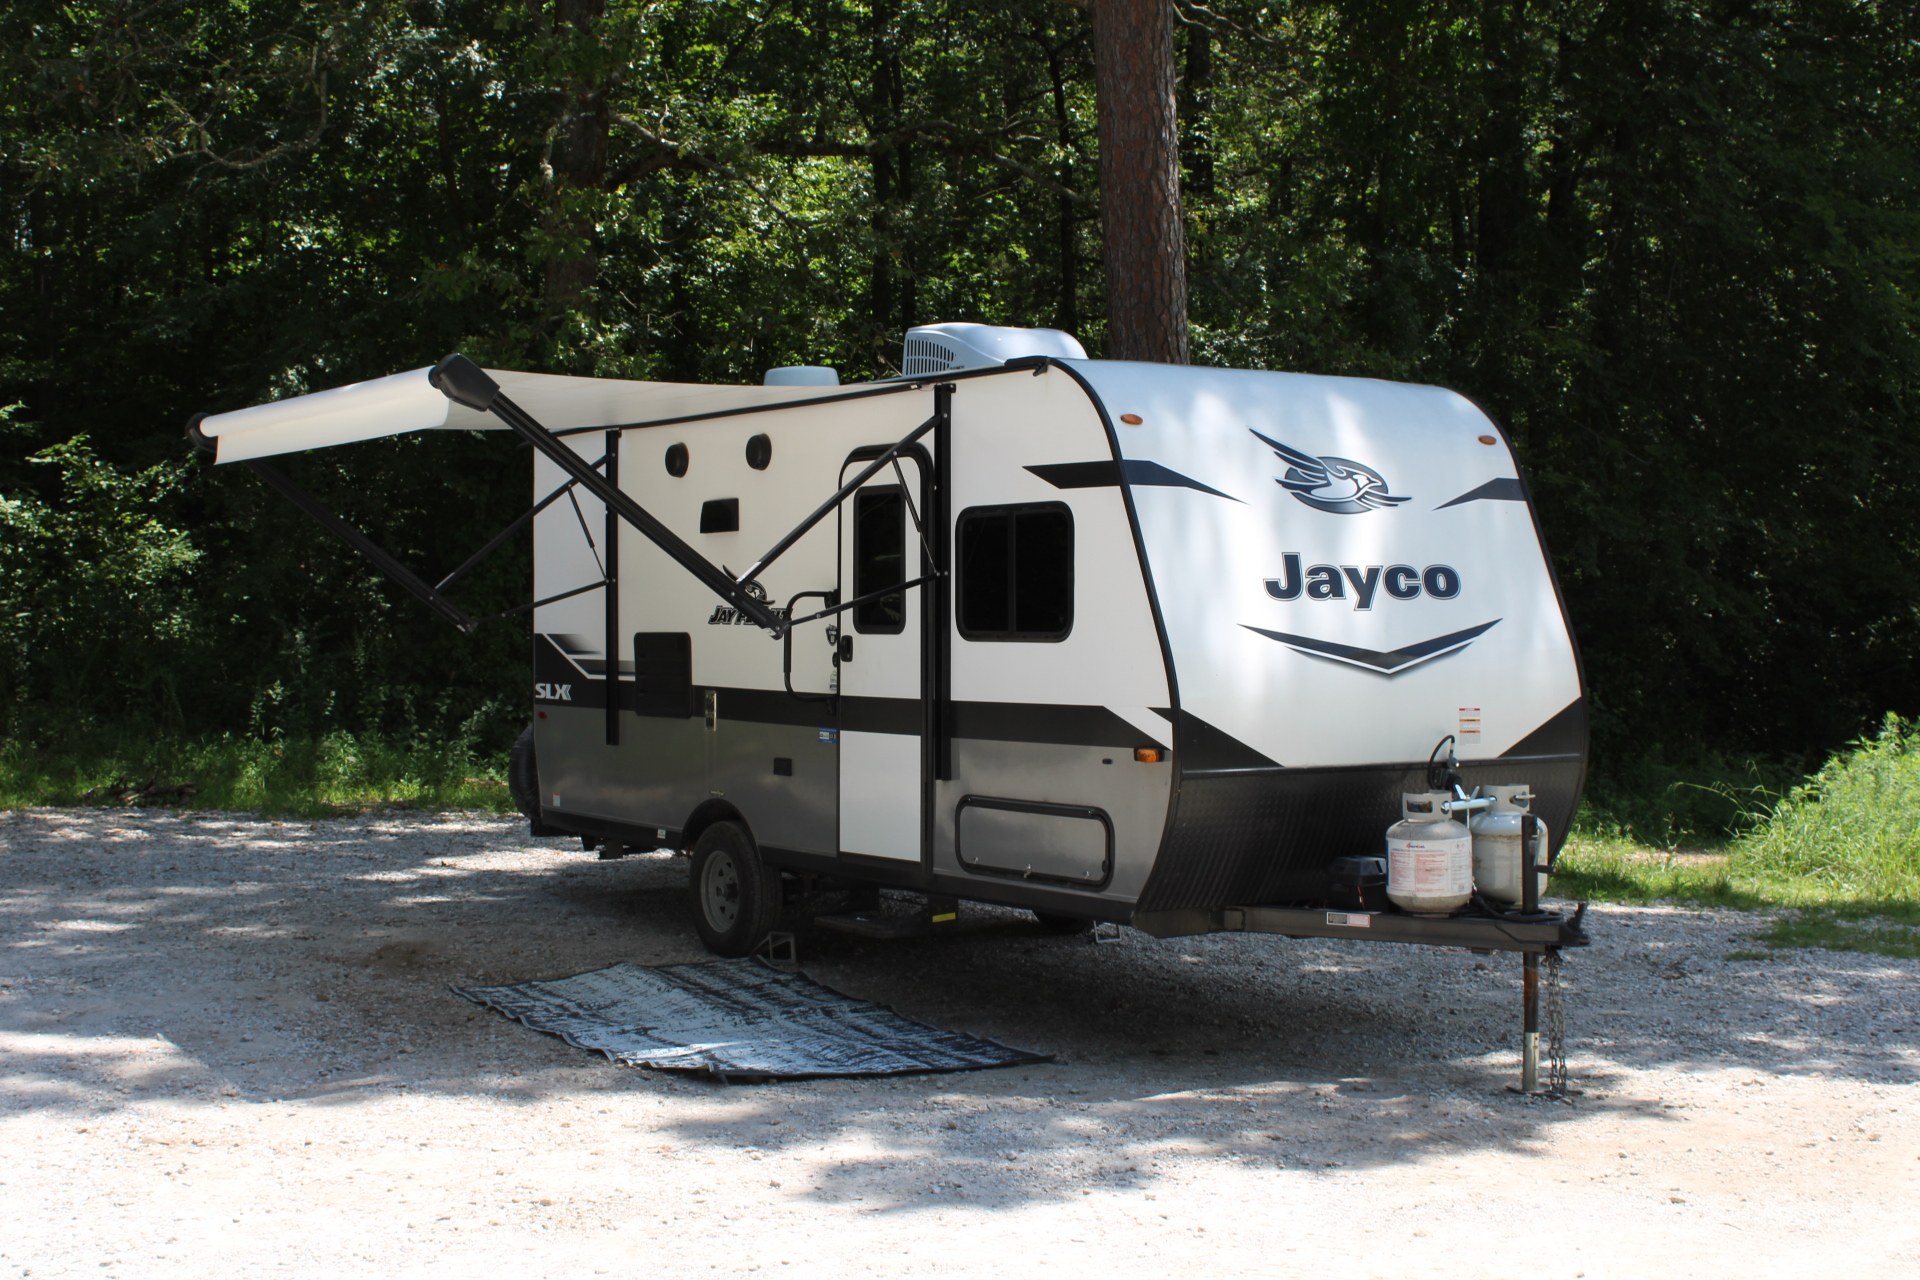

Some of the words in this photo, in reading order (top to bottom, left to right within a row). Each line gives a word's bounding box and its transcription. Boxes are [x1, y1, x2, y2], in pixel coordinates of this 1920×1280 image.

[1263, 552, 1461, 611] Jayco
[708, 605, 737, 625] JAY
[535, 682, 572, 701] SLX
